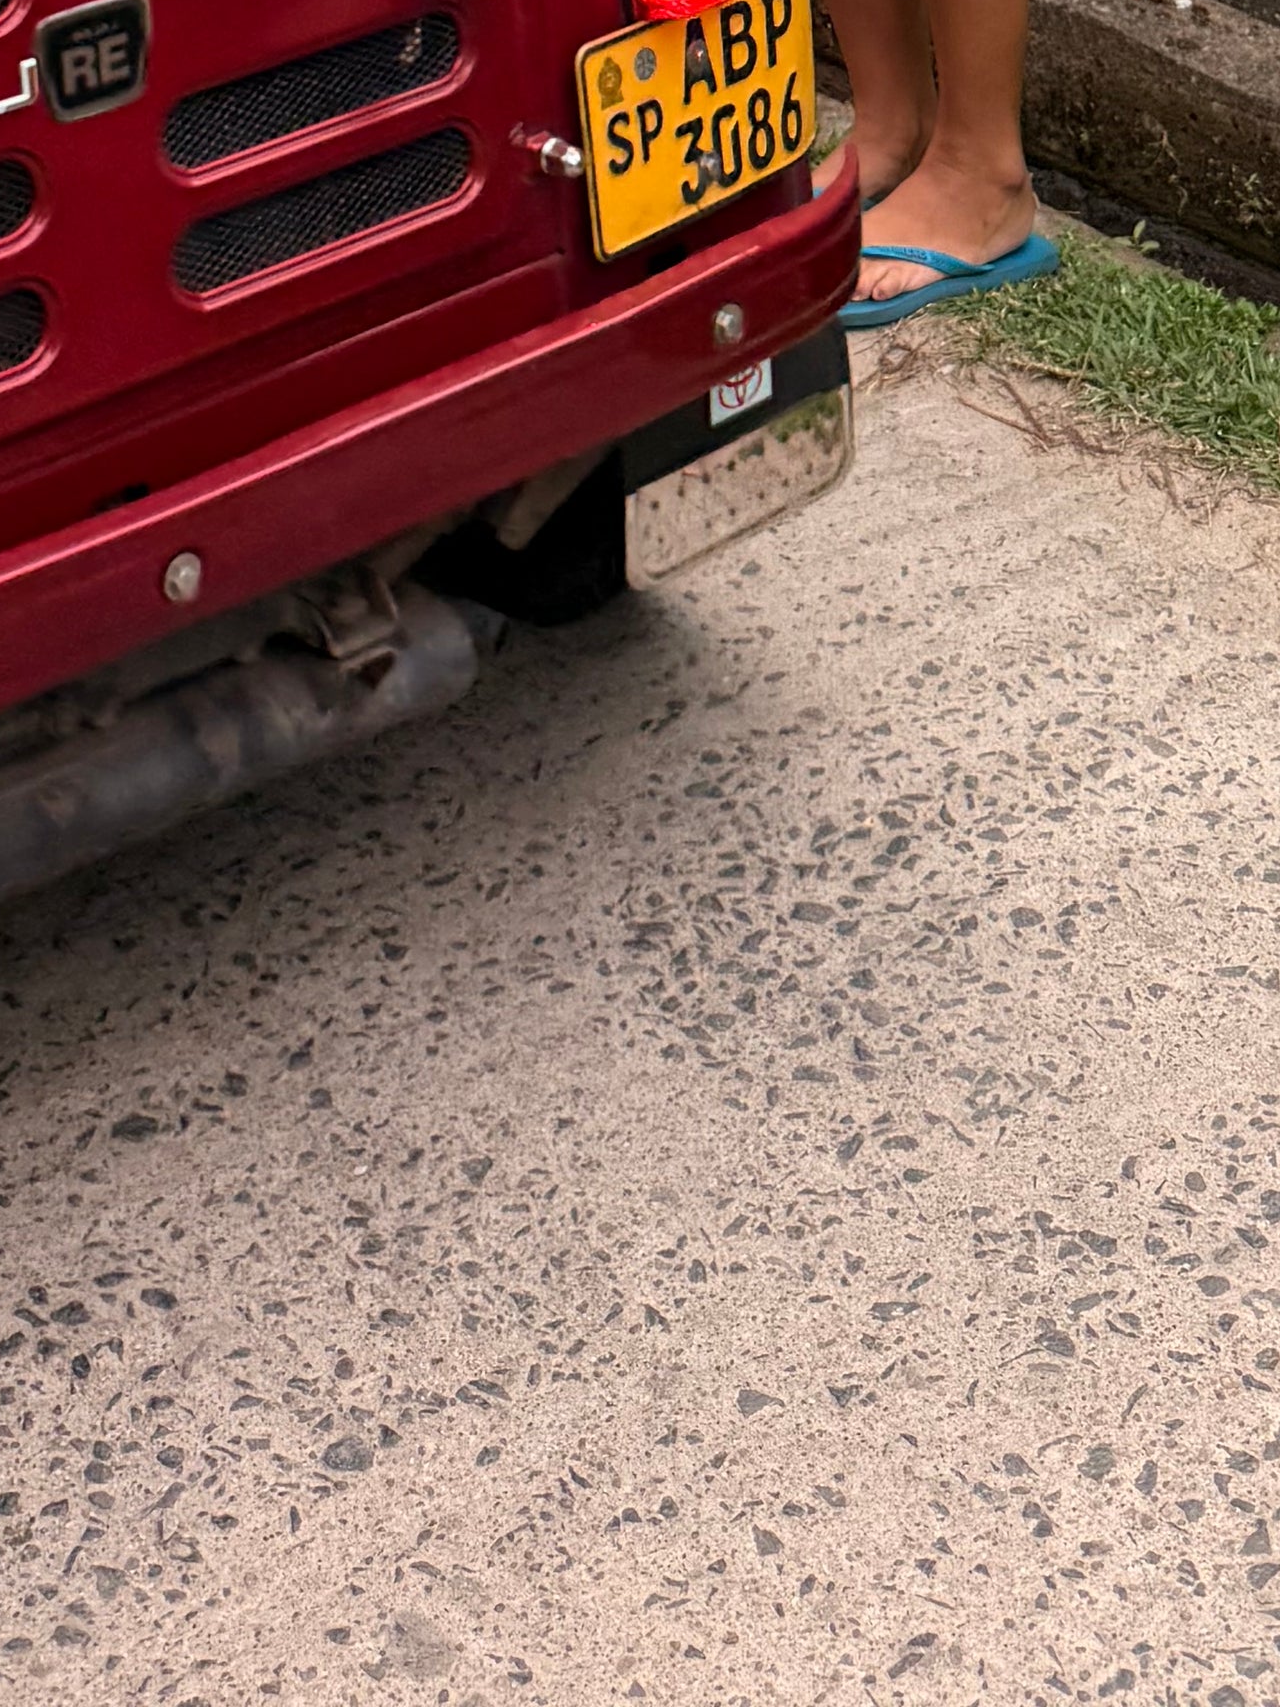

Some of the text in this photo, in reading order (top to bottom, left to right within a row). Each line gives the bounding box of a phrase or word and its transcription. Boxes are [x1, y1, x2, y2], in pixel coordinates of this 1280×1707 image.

[61, 31, 131, 96] RE
[607, 71, 803, 205] SP 3086
